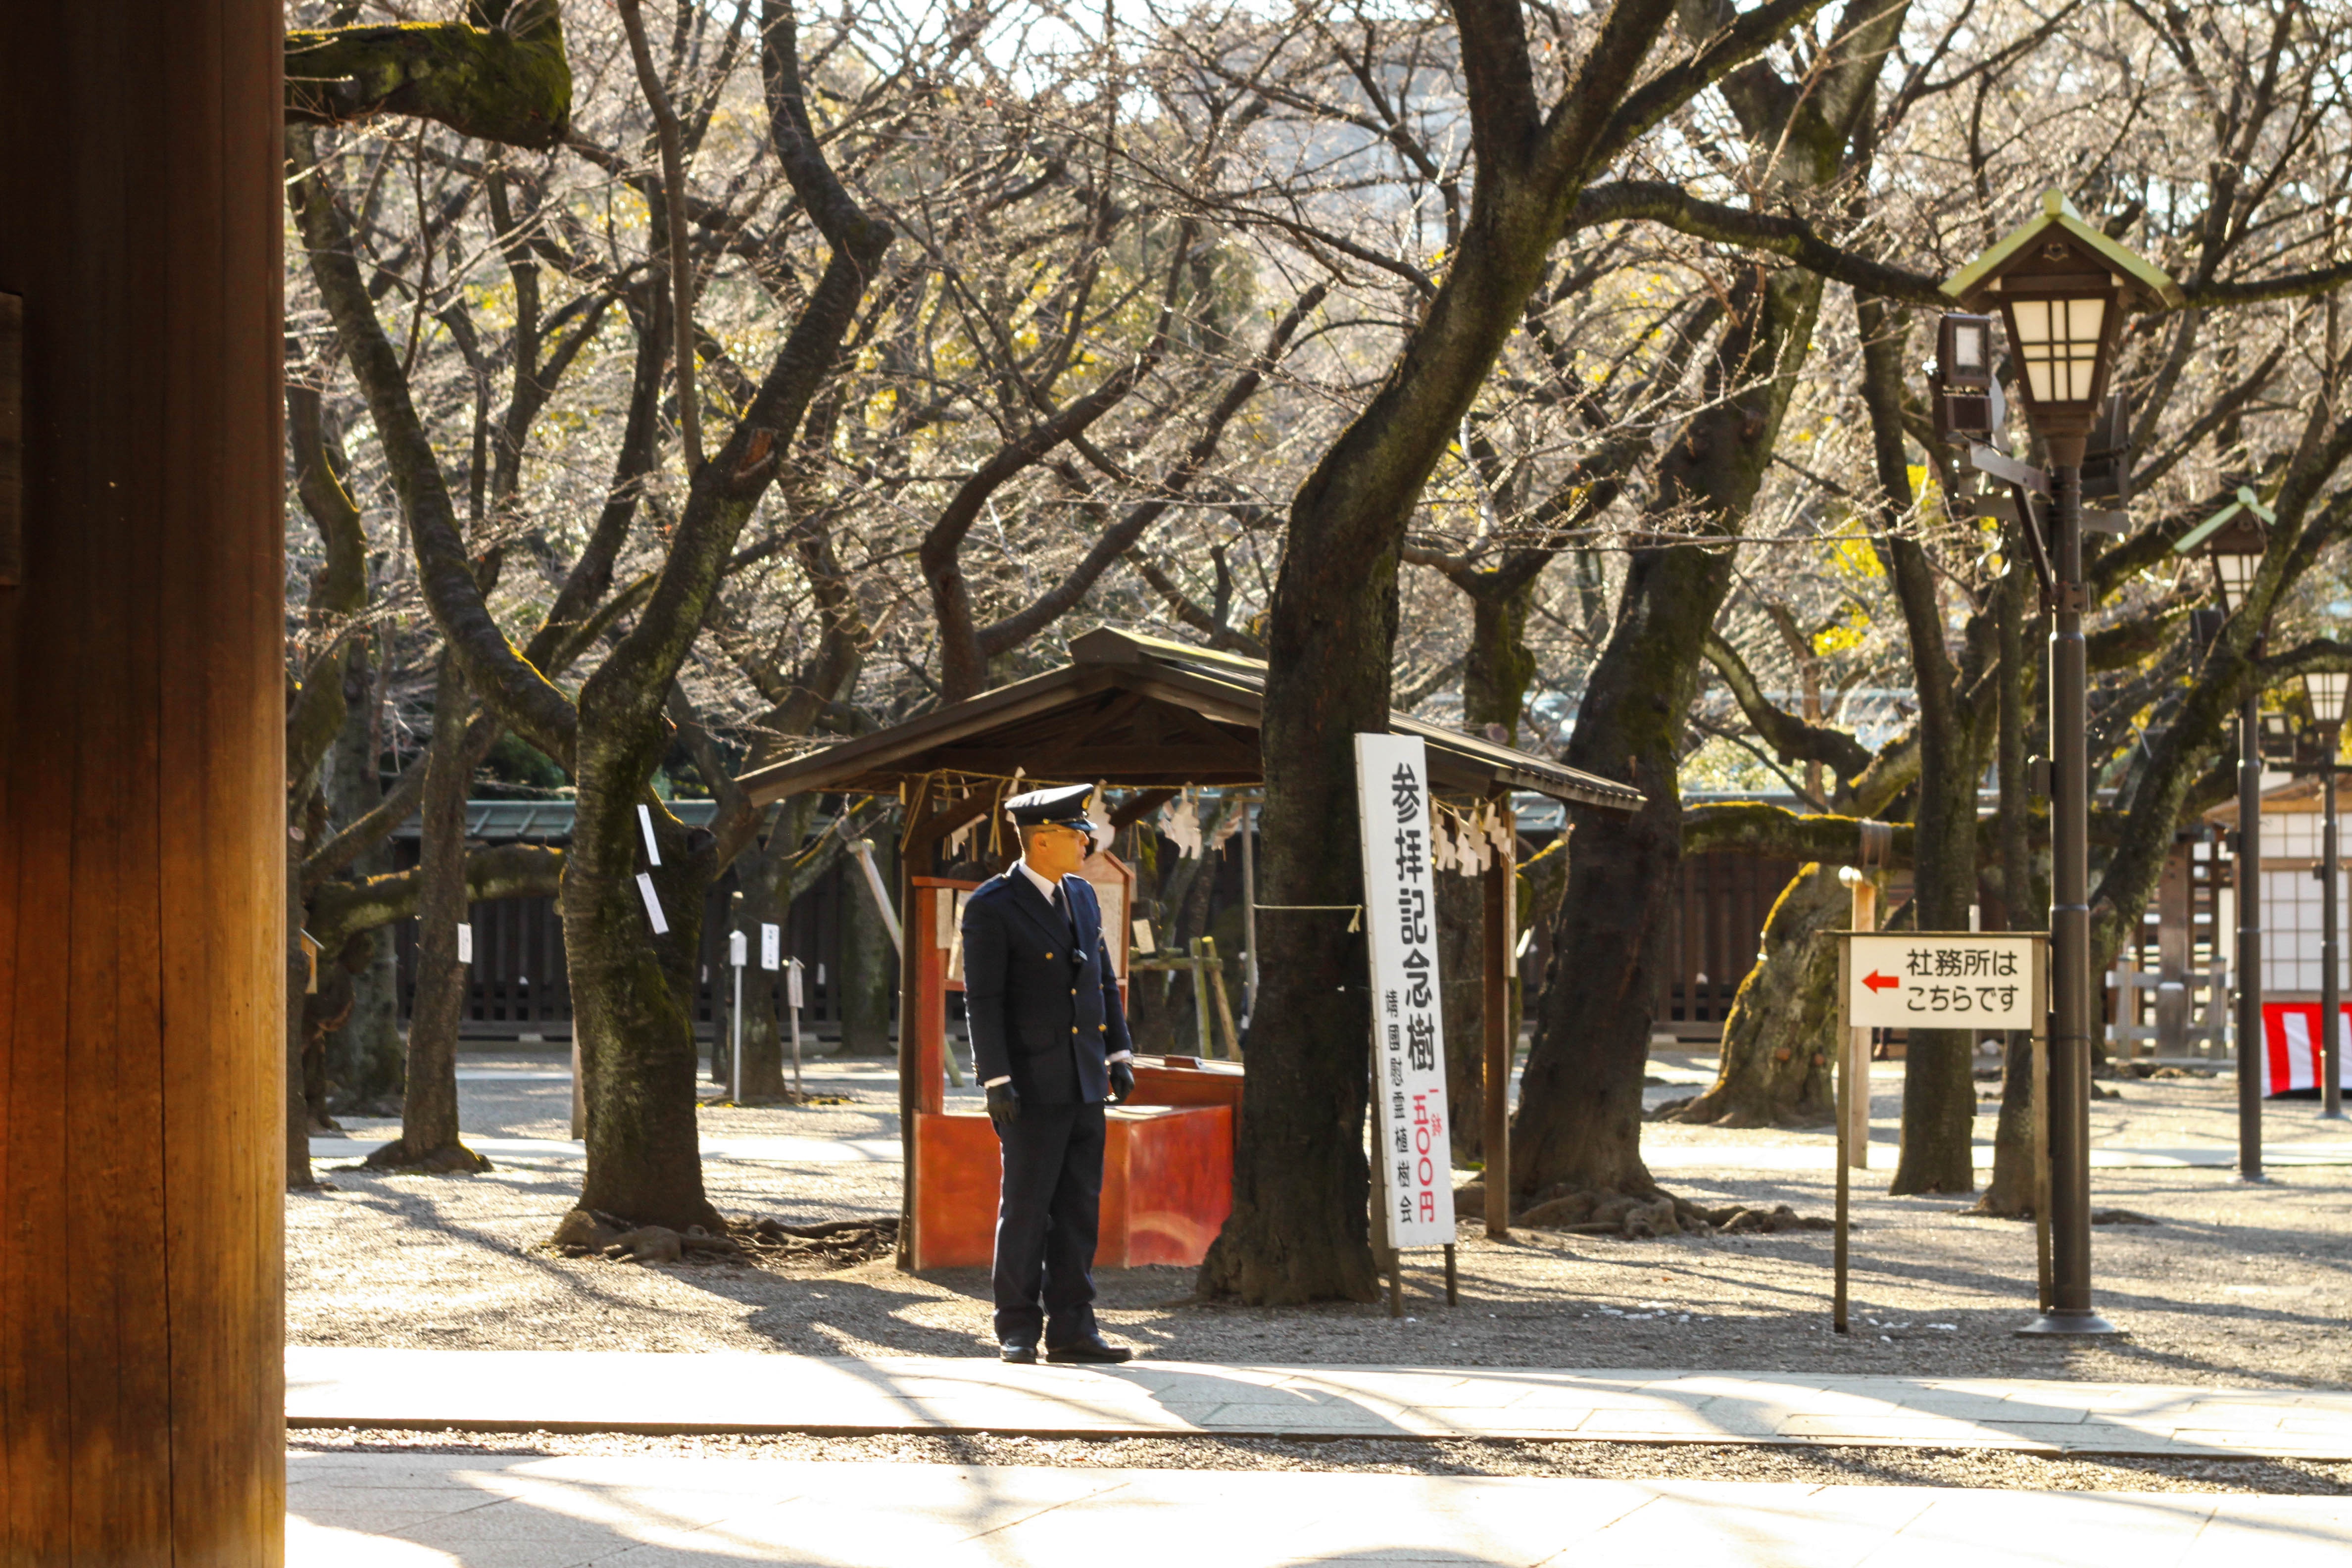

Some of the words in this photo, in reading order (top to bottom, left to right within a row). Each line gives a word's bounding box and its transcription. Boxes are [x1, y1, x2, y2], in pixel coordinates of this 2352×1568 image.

[1391, 762, 1434, 1071] 参拝記念樹
[1906, 948, 2018, 977] 社務所は
[1907, 984, 2019, 1012] こちらです
